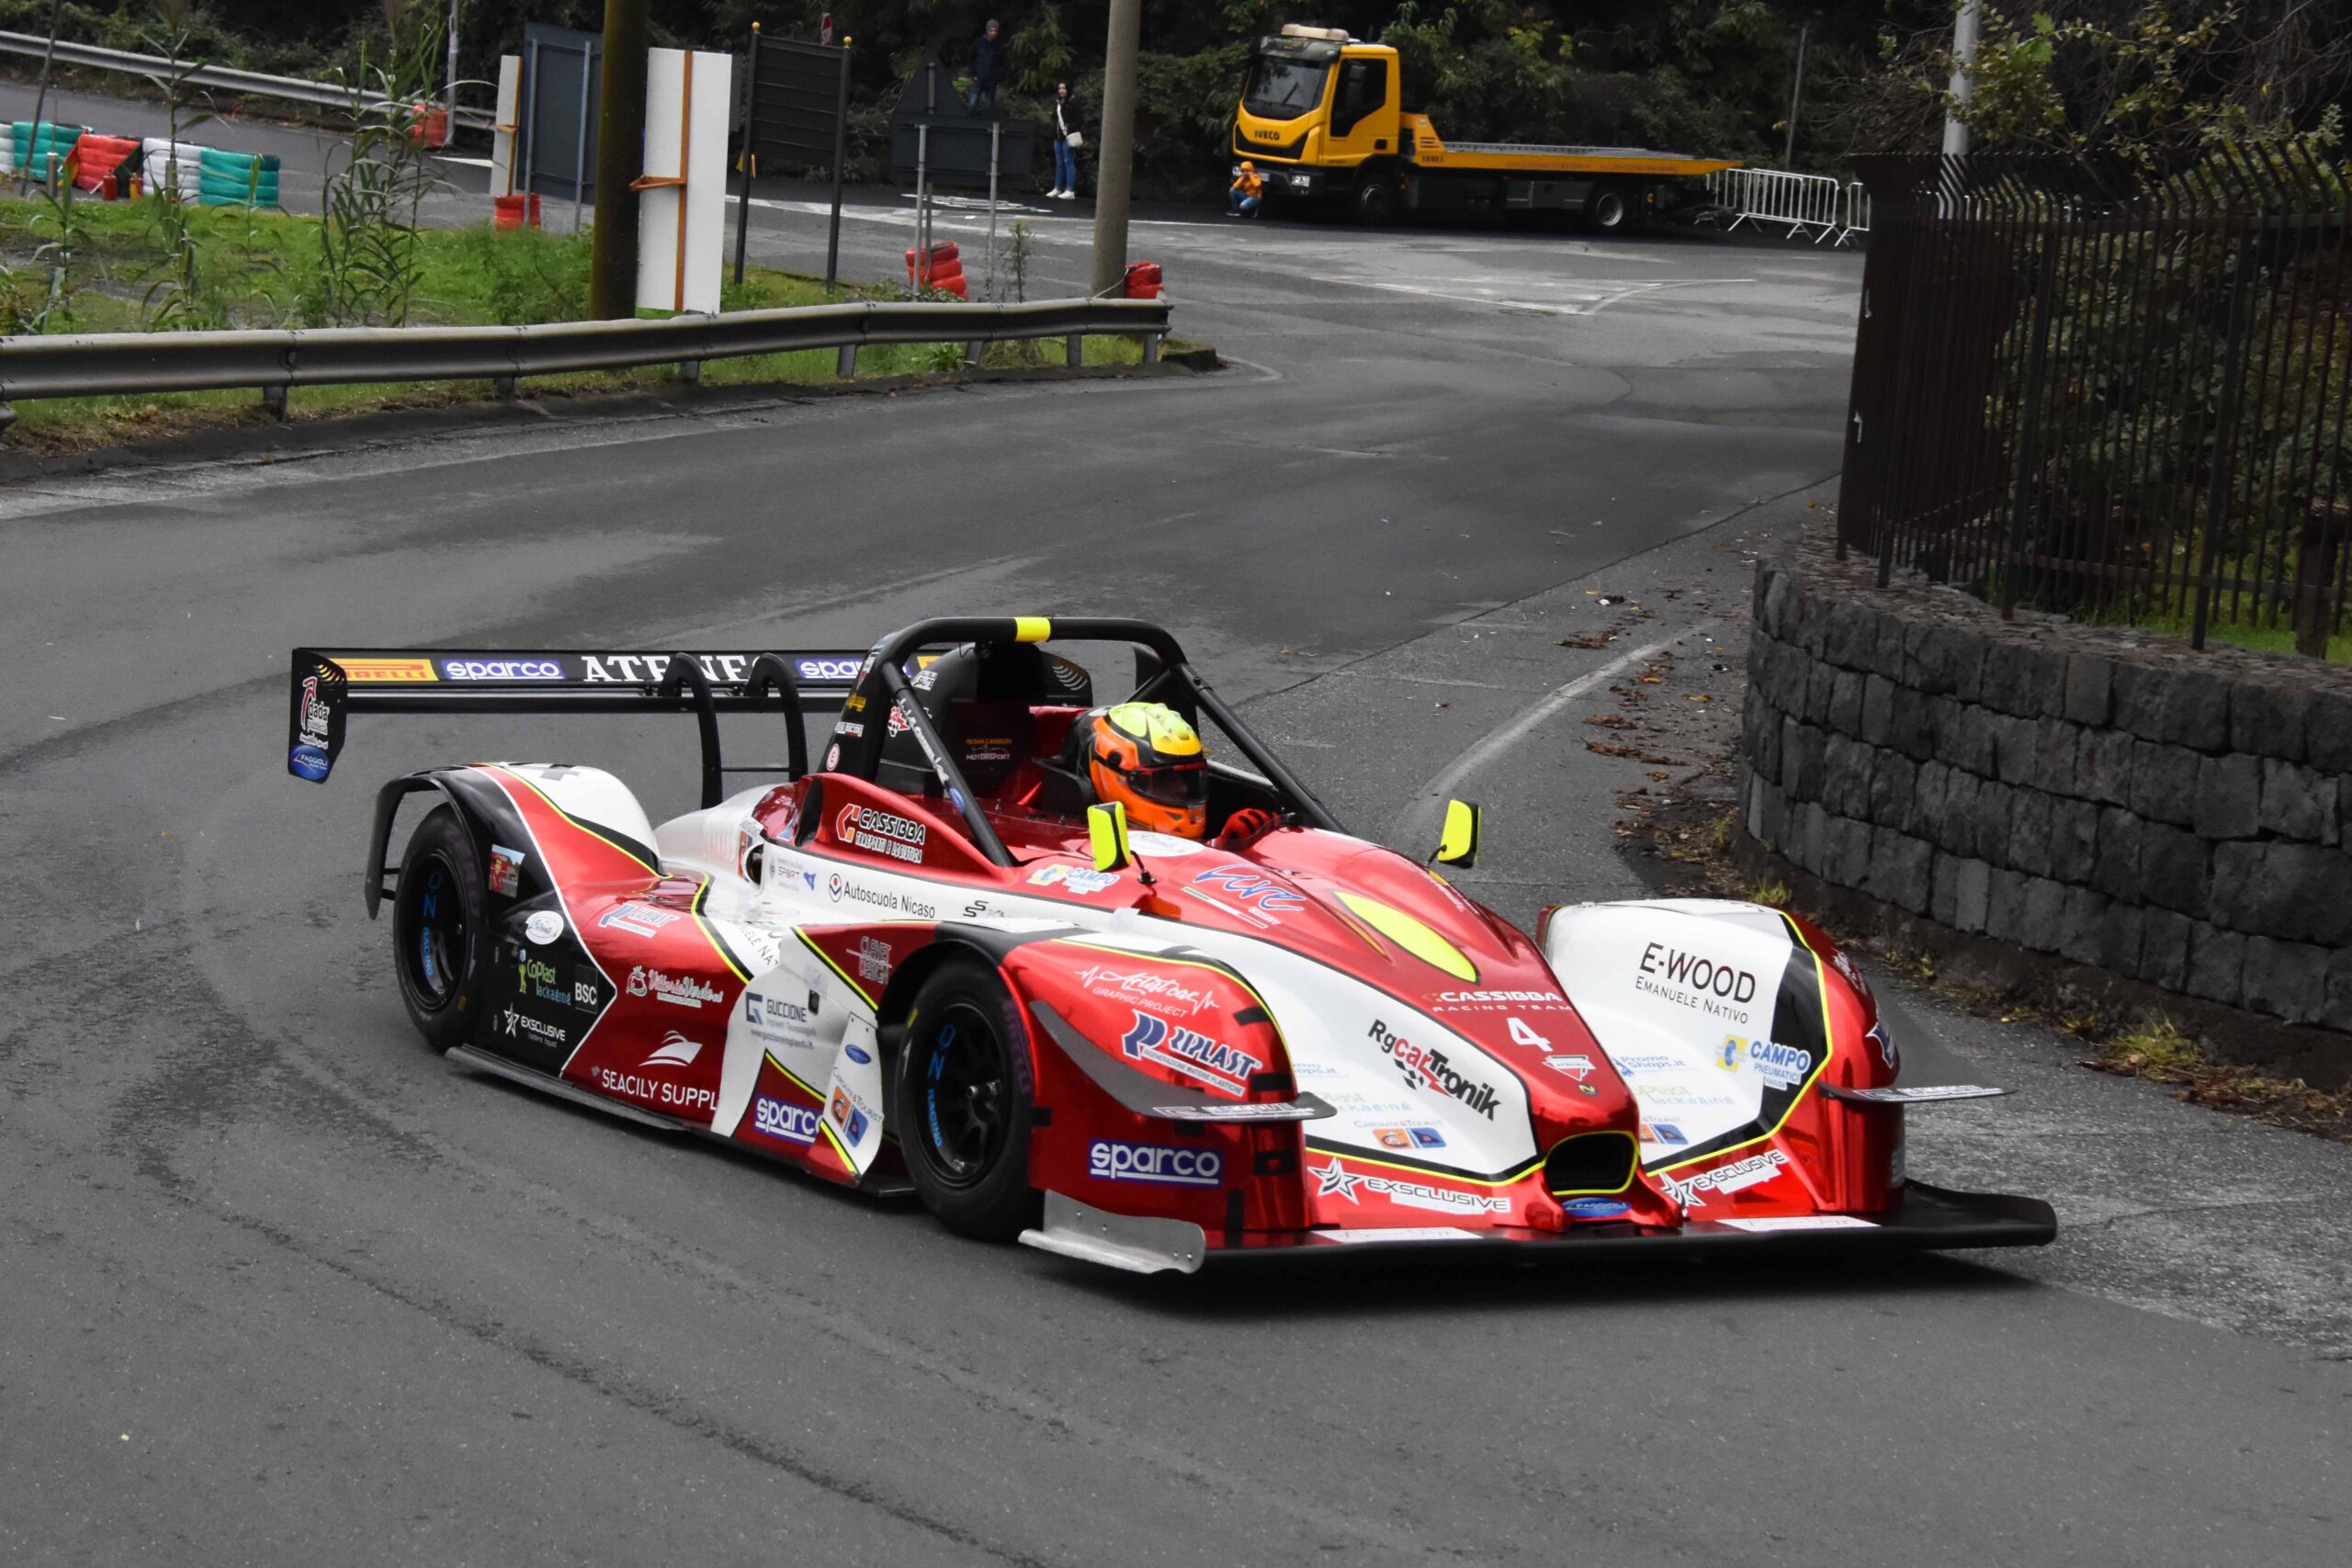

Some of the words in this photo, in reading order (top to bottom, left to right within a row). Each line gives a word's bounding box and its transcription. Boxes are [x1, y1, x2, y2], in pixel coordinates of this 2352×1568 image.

[1254, 130, 1281, 141] IVECO
[447, 660, 563, 680] sparco
[300, 753, 328, 767] FAGGIOLI
[859, 807, 926, 845] CASSIBBA
[1065, 867, 1121, 886] CAMPO
[843, 884, 899, 910] Autoscuola
[901, 895, 935, 919] Nicaso
[574, 981, 597, 1005] BSC
[1091, 986, 1138, 1006] GRAPHIC
[1138, 998, 1189, 1018] PROJECT
[1439, 990, 1563, 1002] CASSIBBA
[766, 998, 808, 1022] GUCCIONE
[520, 1015, 567, 1042] EXSCLUSIVE
[1507, 1017, 1554, 1052] 4
[1620, 1055, 1668, 1063] Promo
[1750, 1040, 1809, 1071] CAMPO
[601, 1068, 659, 1100] SEACILY
[1753, 1061, 1801, 1083] PNEUMATICI
[927, 1088, 943, 1147] RACING
[1091, 1142, 1220, 1183] sparco
[1694, 1151, 1785, 1190] EXSCLUSIVE
[1367, 1179, 1508, 1212] EXSCLUSIVE
